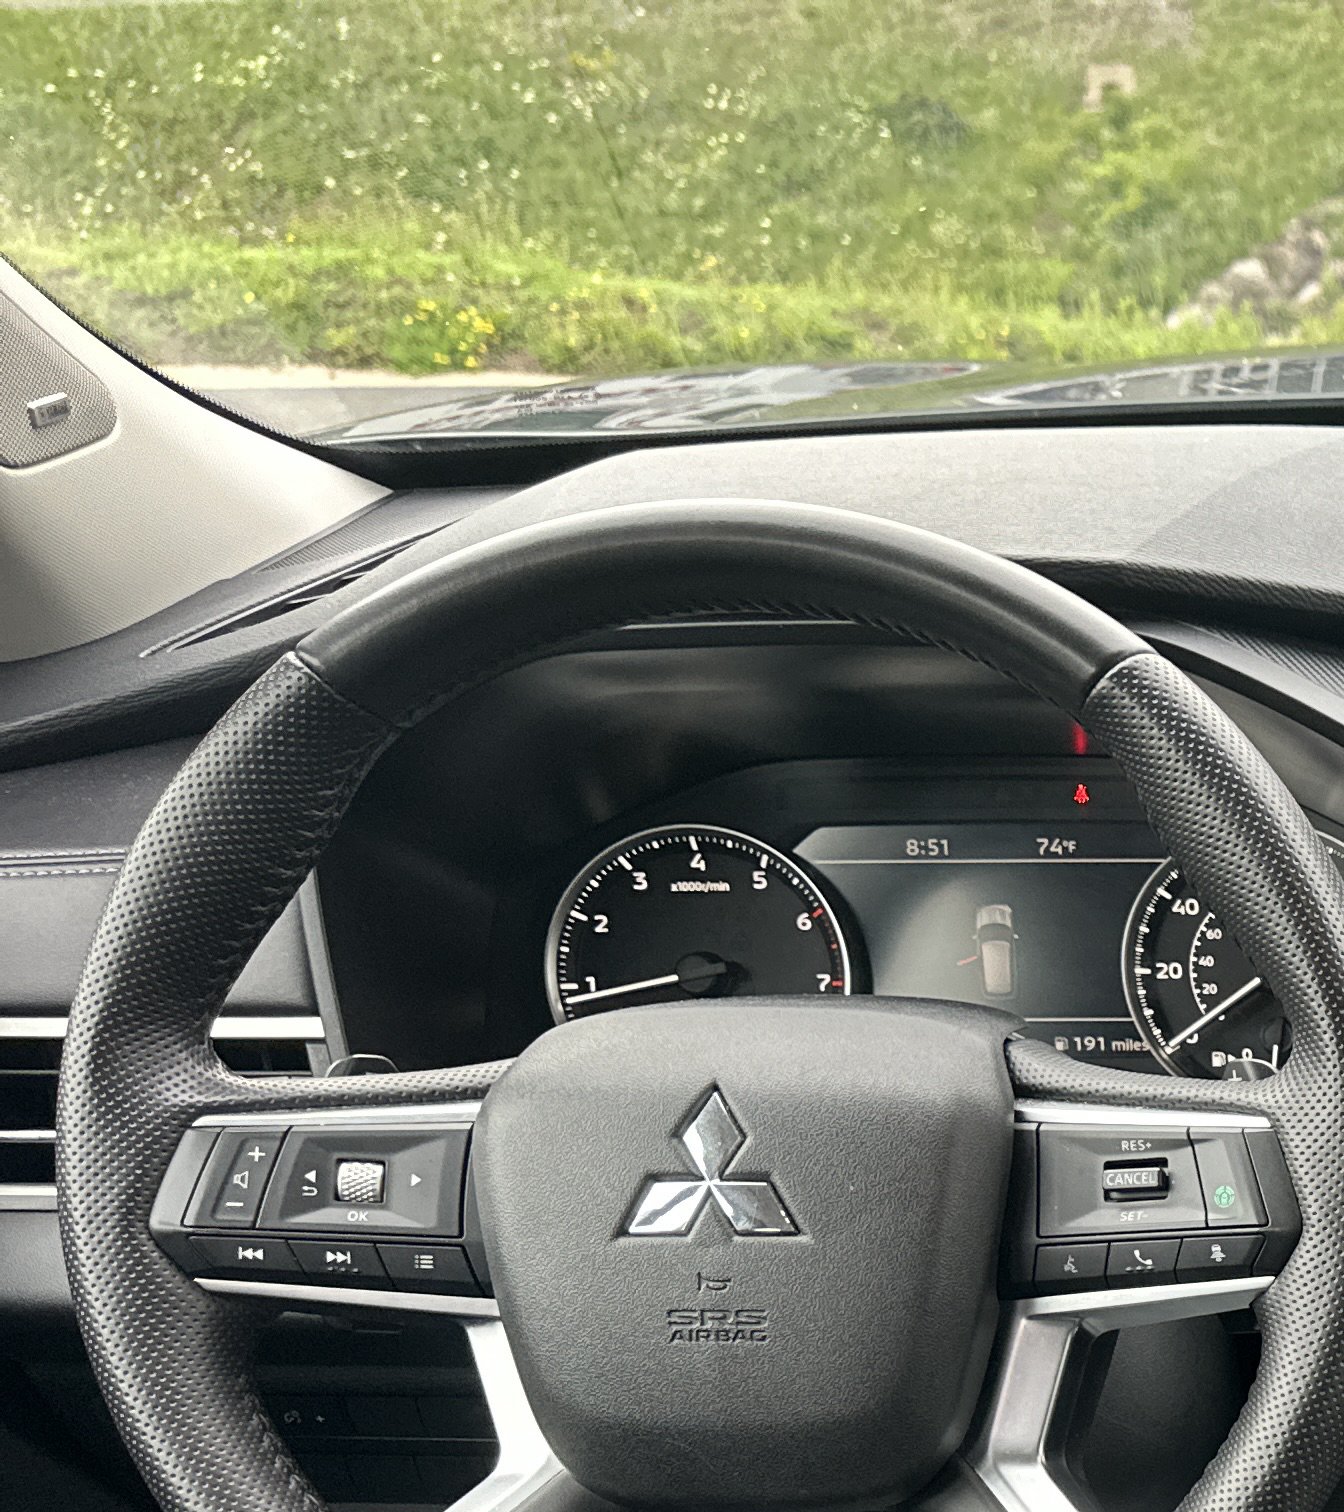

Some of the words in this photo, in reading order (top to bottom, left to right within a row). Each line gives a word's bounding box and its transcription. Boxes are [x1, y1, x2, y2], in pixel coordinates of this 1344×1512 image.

[905, 839, 950, 857] 8:51
[1035, 837, 1077, 857] 74°F
[690, 853, 706, 871] 4
[631, 872, 649, 891] 3
[752, 871, 768, 890] 5
[1171, 897, 1200, 916] 40
[593, 915, 610, 934] 2
[796, 913, 812, 932] 6
[1205, 928, 1223, 940] 60
[1198, 955, 1215, 967] 40
[1155, 961, 1183, 980] 20
[585, 976, 597, 993] 1
[816, 974, 832, 991] 7
[1202, 983, 1218, 995] 20
[1073, 1036, 1106, 1052] 191
[1121, 1138, 1153, 1152] RES+
[1106, 1171, 1157, 1187] CANCEL
[347, 1210, 369, 1222] OK
[1119, 1209, 1149, 1223] SET-
[666, 1308, 769, 1326] SRS
[667, 1329, 769, 1344] AIRBAG
